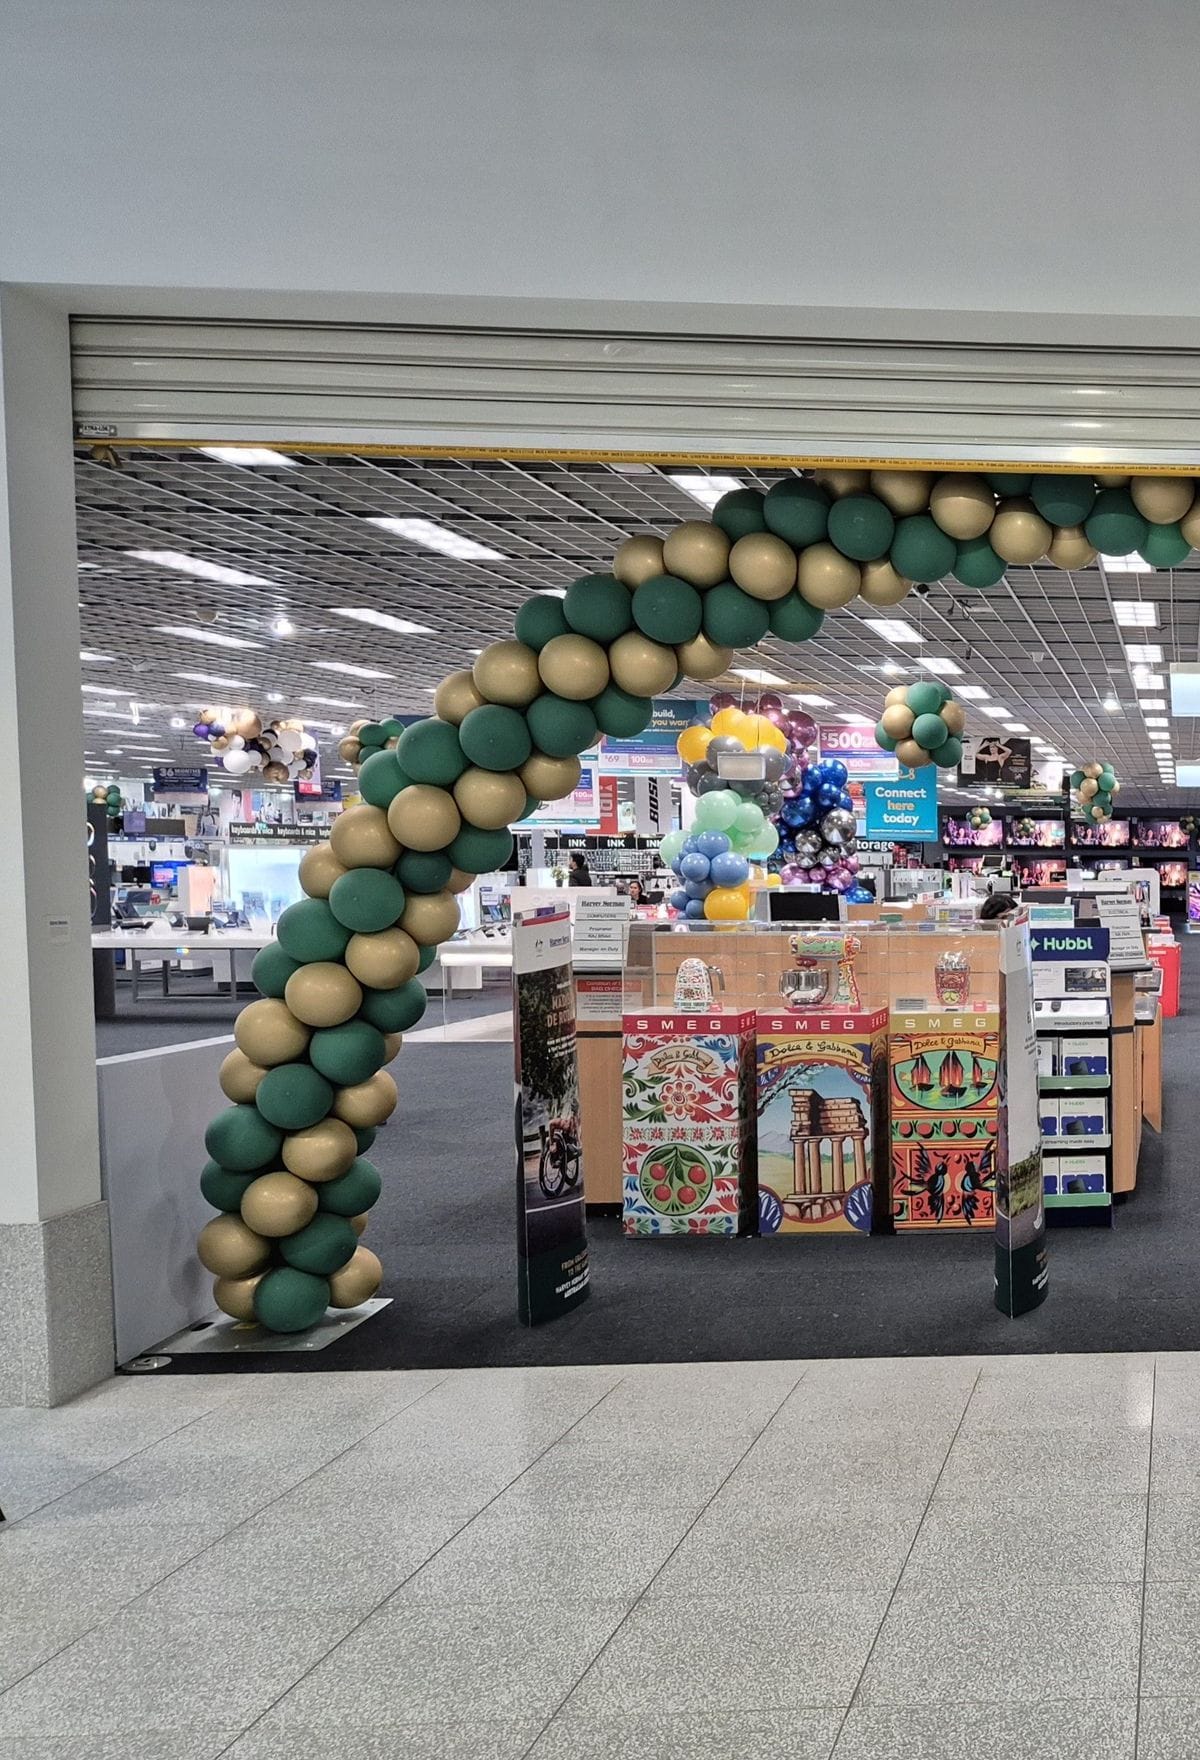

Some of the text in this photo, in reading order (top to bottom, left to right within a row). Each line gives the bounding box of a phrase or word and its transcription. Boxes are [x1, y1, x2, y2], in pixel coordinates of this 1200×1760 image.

[652, 710, 675, 718] build,
[652, 719, 668, 727] you
[821, 732, 863, 748] $500
[159, 768, 174, 777] 36
[875, 787, 927, 799] Connect
[887, 800, 914, 811] here
[883, 813, 919, 826] today
[568, 839, 586, 847] INK
[607, 839, 625, 848] INK
[857, 840, 894, 852] torage
[1043, 937, 1093, 951] Hubbl
[636, 1020, 721, 1030] SMEG
[771, 1020, 855, 1030] SMEG
[905, 1018, 986, 1028] SMEG
[914, 1040, 938, 1050] Dolce
[946, 1037, 981, 1048] Gabbana
[770, 1041, 858, 1058] Dolce & Gabbana
